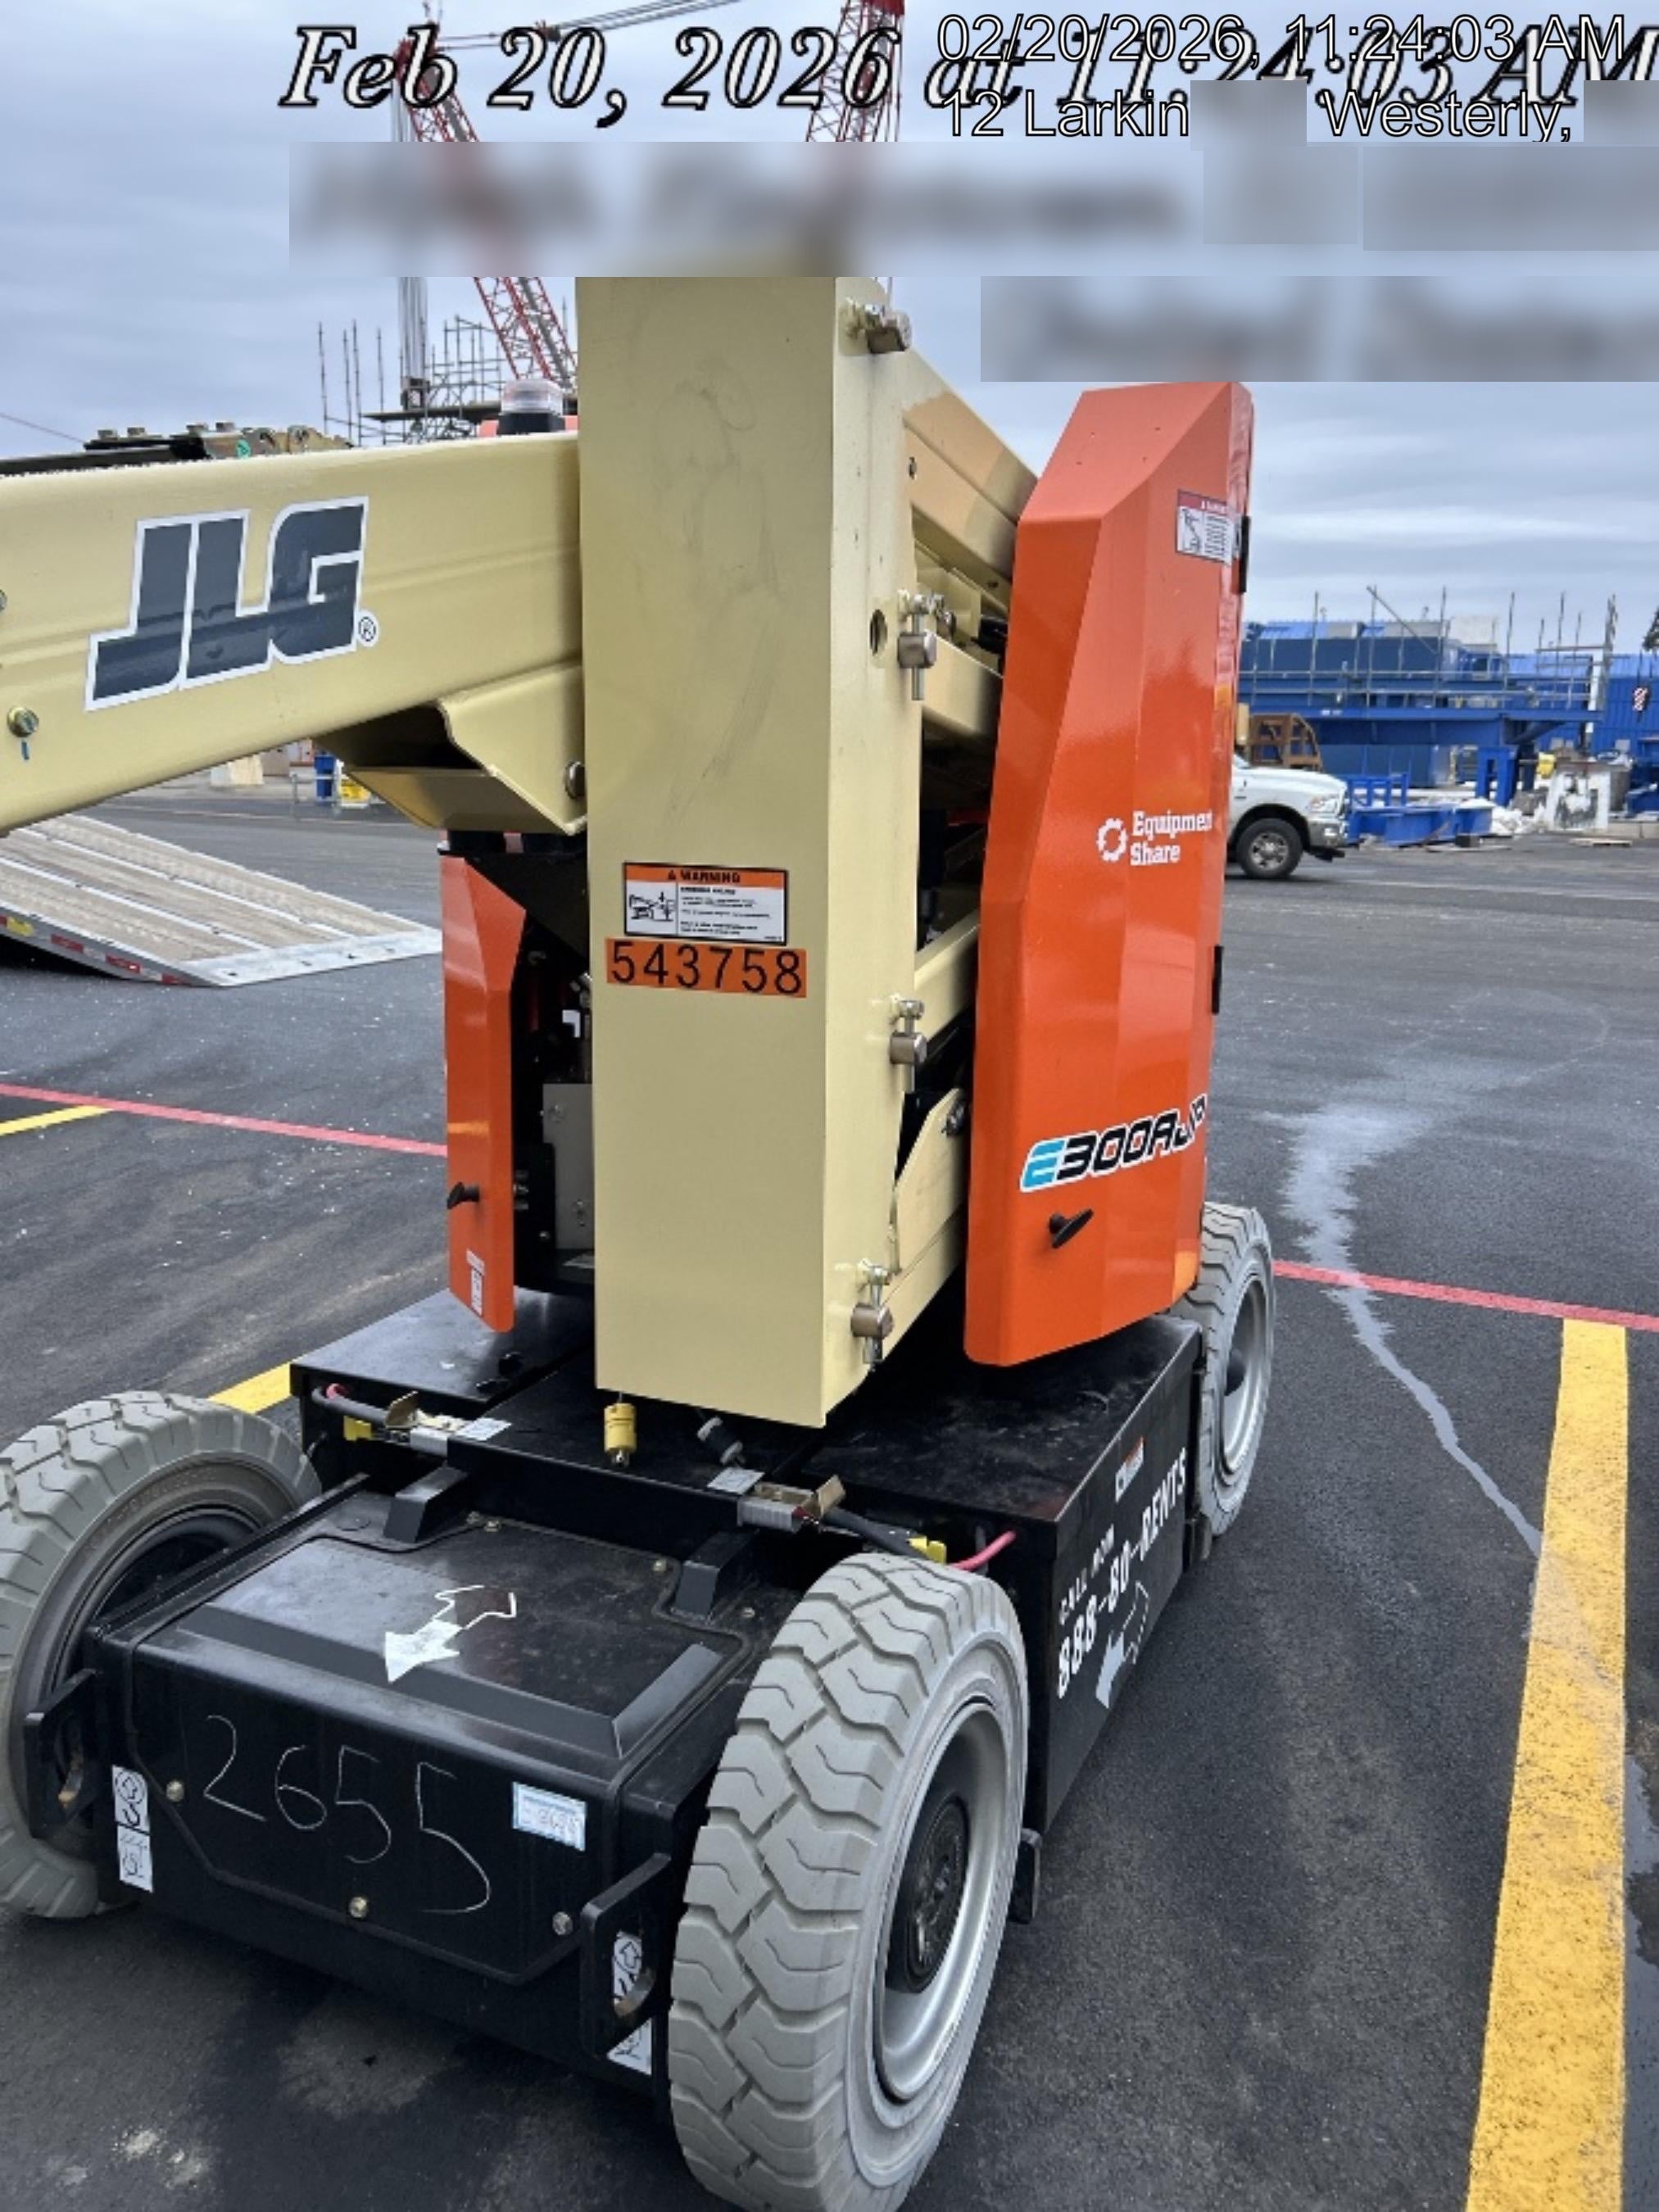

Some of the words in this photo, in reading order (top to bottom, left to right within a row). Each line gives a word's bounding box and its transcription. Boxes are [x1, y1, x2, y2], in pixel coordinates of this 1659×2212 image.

[87, 498, 367, 708] JLG
[1131, 841, 1181, 866] Share
[611, 942, 802, 995] 543758
[202, 1715, 492, 1915] 2655
